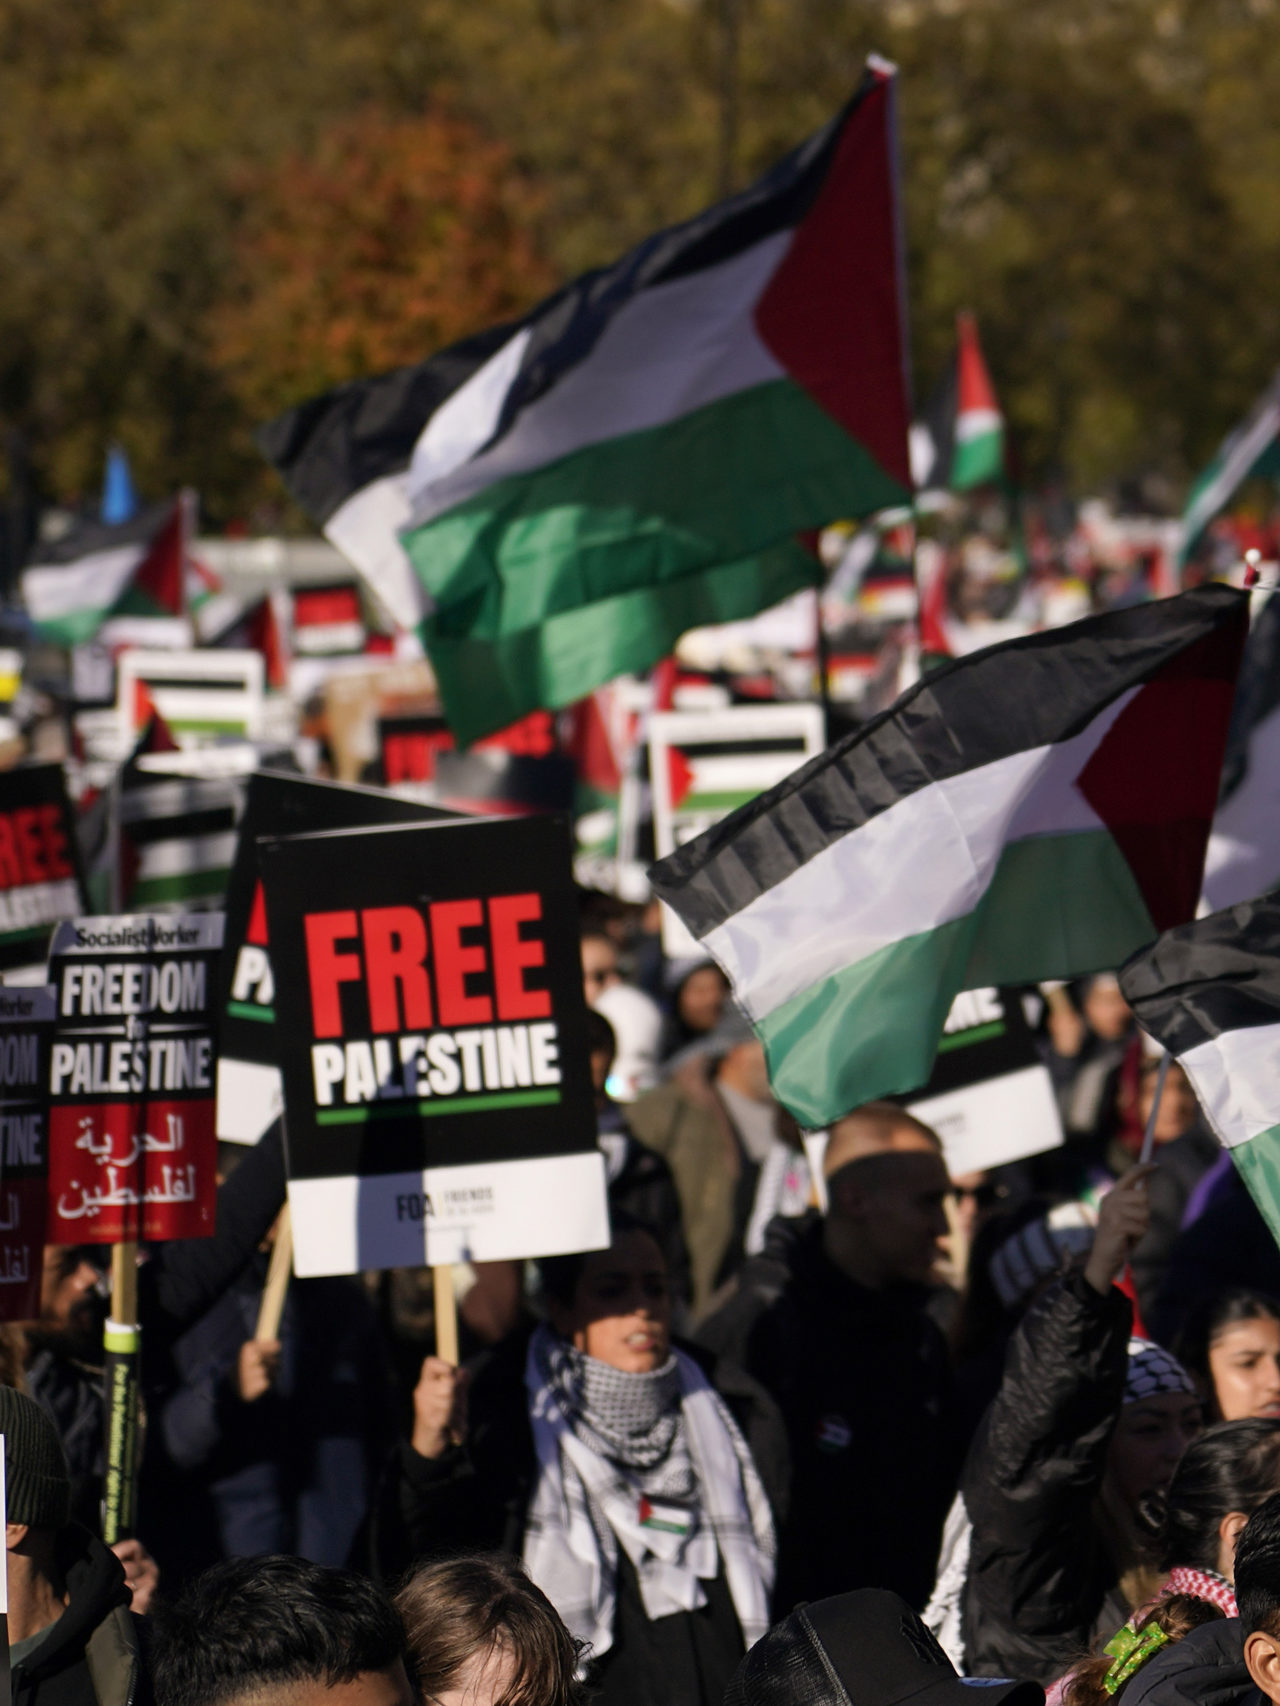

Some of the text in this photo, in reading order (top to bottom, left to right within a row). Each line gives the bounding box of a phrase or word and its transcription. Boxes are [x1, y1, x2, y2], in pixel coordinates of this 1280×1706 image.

[61, 960, 206, 1016] FREEDOM
[304, 892, 552, 1039] FREE
[51, 1038, 211, 1094] PALESTINE
[311, 1023, 561, 1105] PALESTINE
[76, 1113, 184, 1167] الحرية
[58, 1165, 195, 1219] لفلسطين
[396, 1192, 434, 1222] FOA
